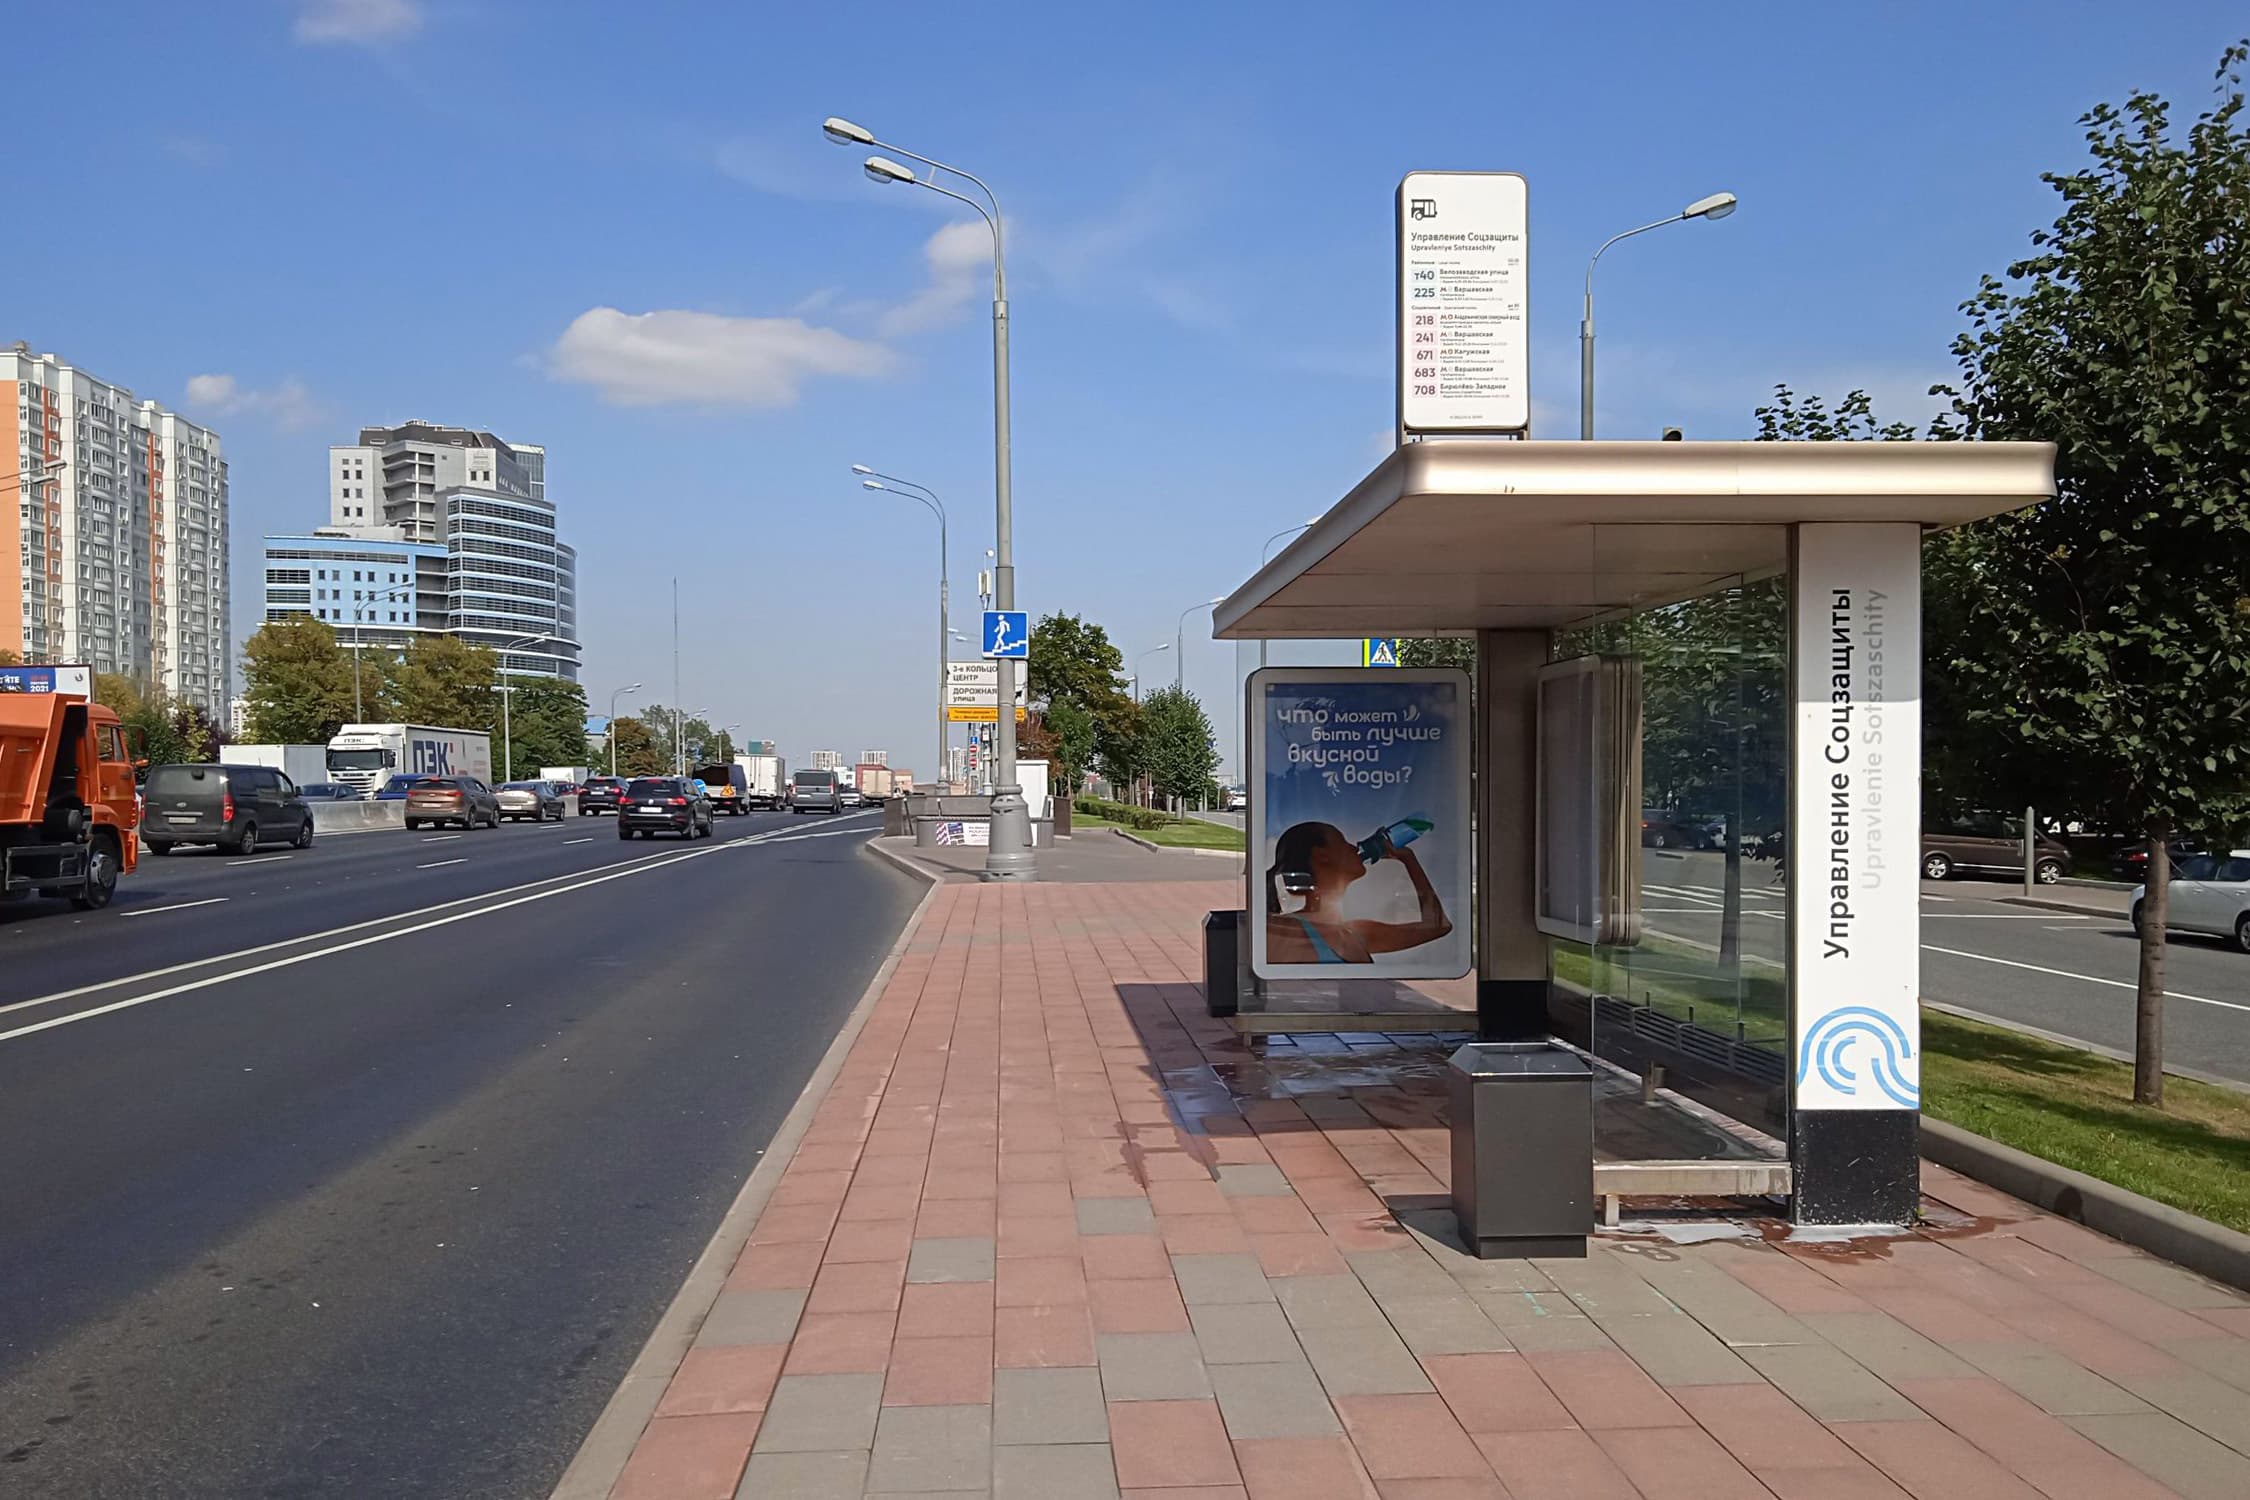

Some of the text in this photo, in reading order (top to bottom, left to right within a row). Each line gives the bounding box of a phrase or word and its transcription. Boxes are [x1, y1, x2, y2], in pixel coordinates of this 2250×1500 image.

[1410, 232, 1519, 242] Управление Соцзащиты
[1453, 244, 1496, 252] Sotszaschity
[1414, 288, 1435, 298] 225
[1415, 315, 1434, 325] 218
[1415, 333, 1434, 343] 241
[1416, 350, 1433, 360] 671
[1414, 368, 1436, 378] 683
[1414, 385, 1436, 395] 708
[966, 665, 998, 673] КОЛЬЦО
[1334, 711, 1398, 723] может
[1311, 726, 1441, 746] быть лучше
[1861, 588, 1889, 889] Upravlenie Sotszaschity
[1287, 743, 1380, 768] вкусной
[1343, 764, 1413, 790] воды?
[1823, 588, 1856, 959] Управление Соцзащиты
